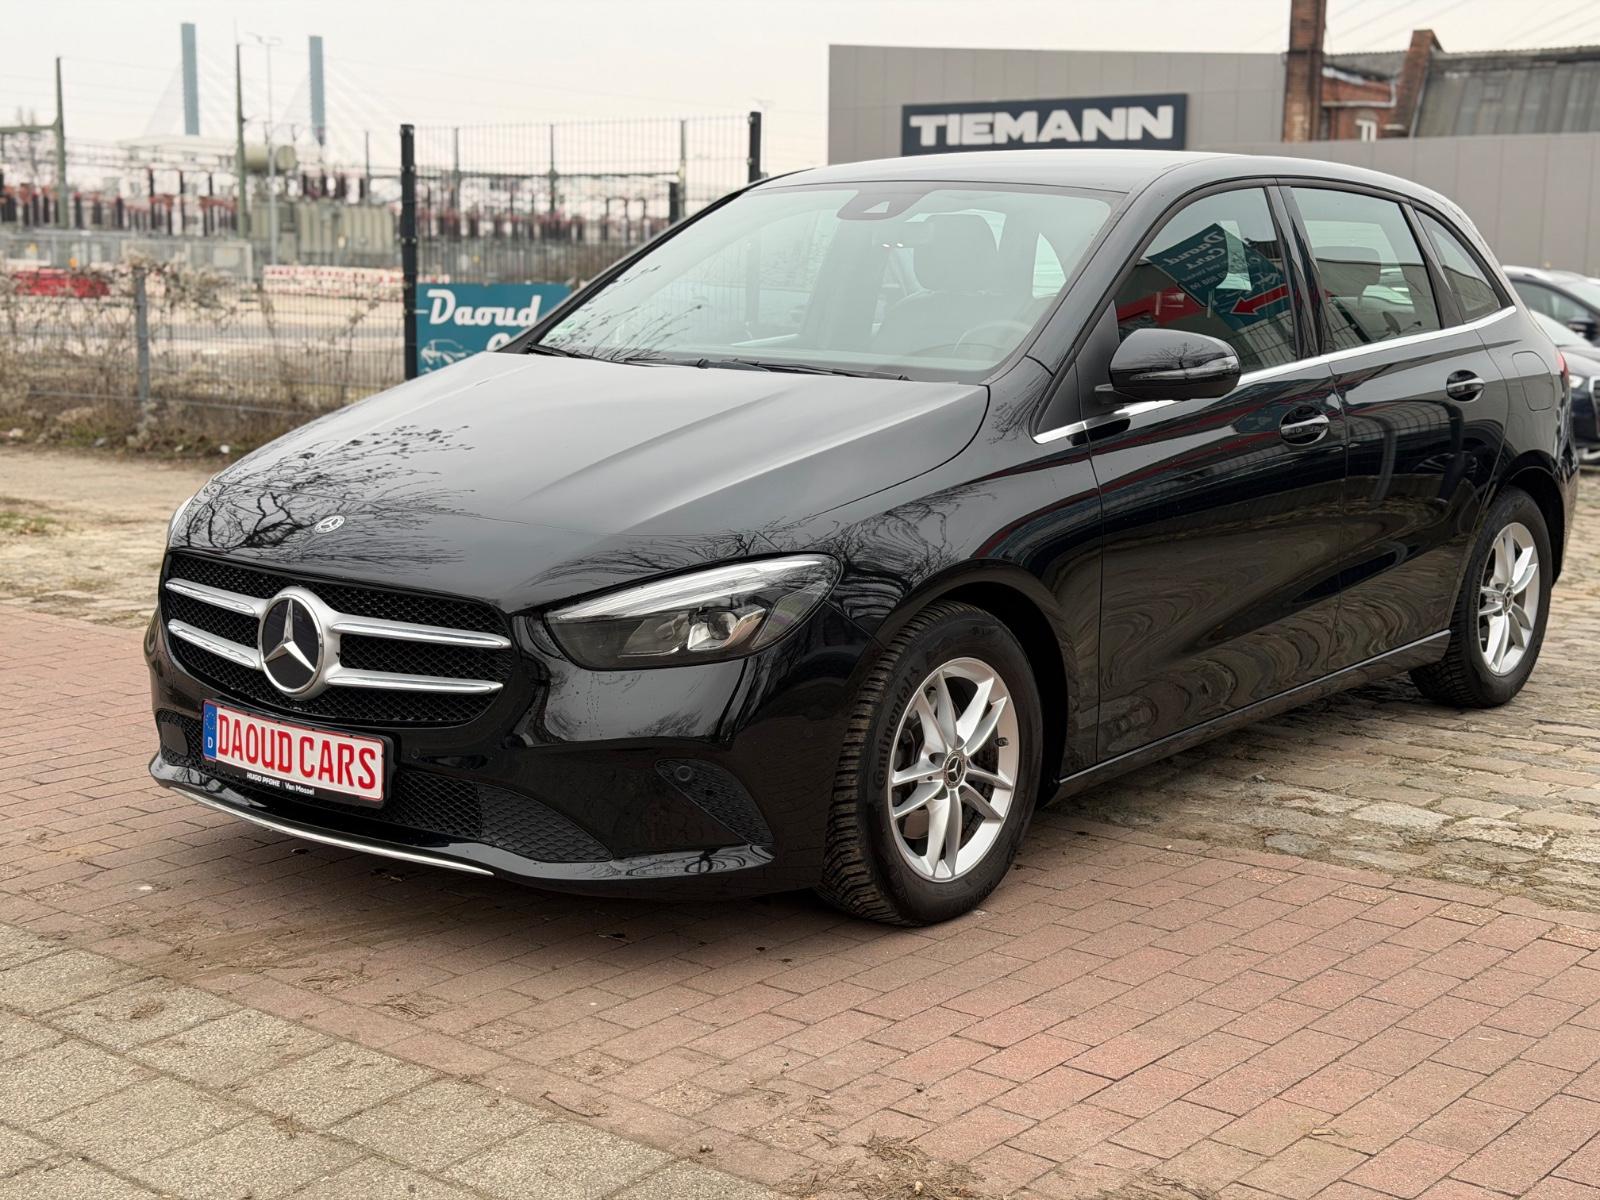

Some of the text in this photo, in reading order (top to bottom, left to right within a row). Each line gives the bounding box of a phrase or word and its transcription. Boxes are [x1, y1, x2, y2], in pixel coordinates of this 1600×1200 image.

[909, 105, 1175, 146] TIEMANN
[426, 288, 542, 326] Daoud
[207, 736, 214, 748] D
[217, 713, 376, 790] DAOUD CARS
[246, 771, 262, 782] HUGO
[284, 782, 296, 792] Van
[295, 784, 315, 796] Mossel
